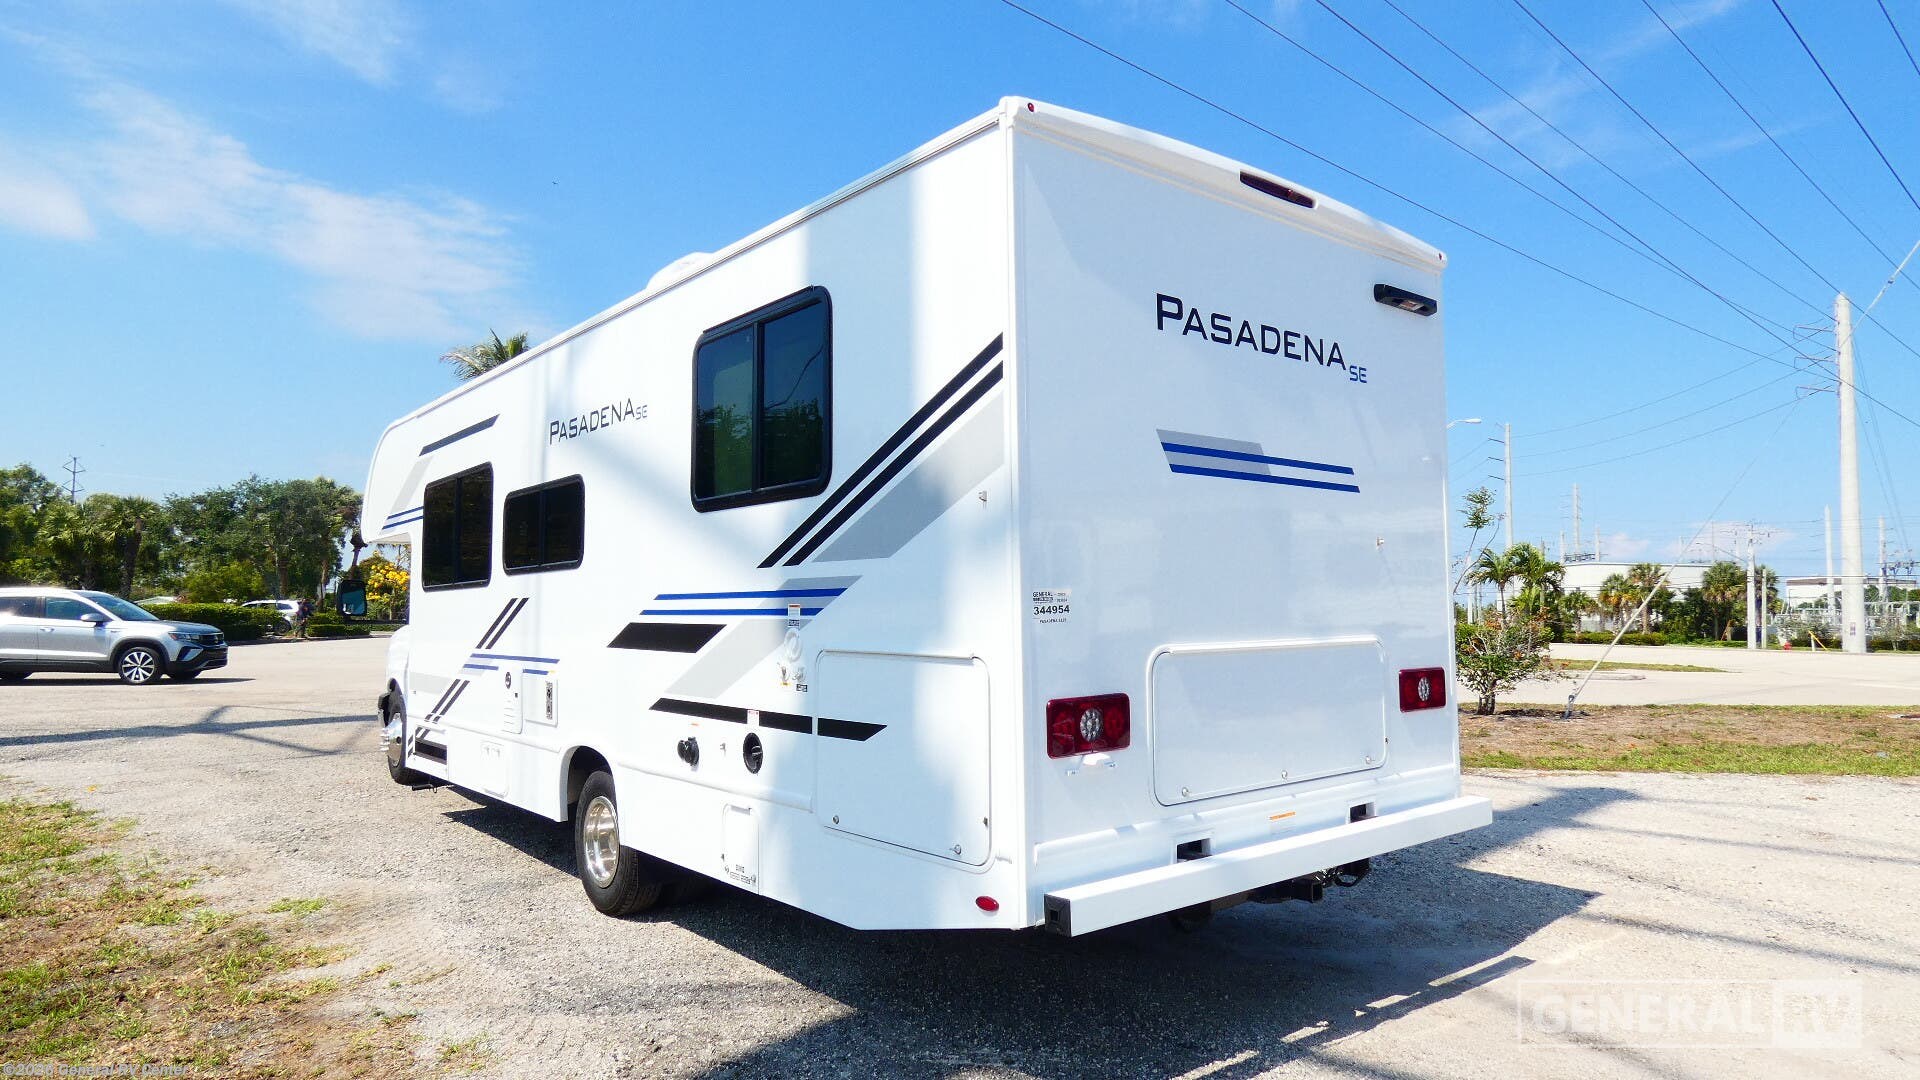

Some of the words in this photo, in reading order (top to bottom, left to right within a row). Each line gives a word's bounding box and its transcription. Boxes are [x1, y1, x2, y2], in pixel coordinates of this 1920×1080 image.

[1156, 293, 1347, 371] PASADENA
[1349, 365, 1367, 384] SE
[549, 398, 635, 445] PASADENA
[635, 404, 648, 420] SE
[1033, 605, 1070, 615] 344954
